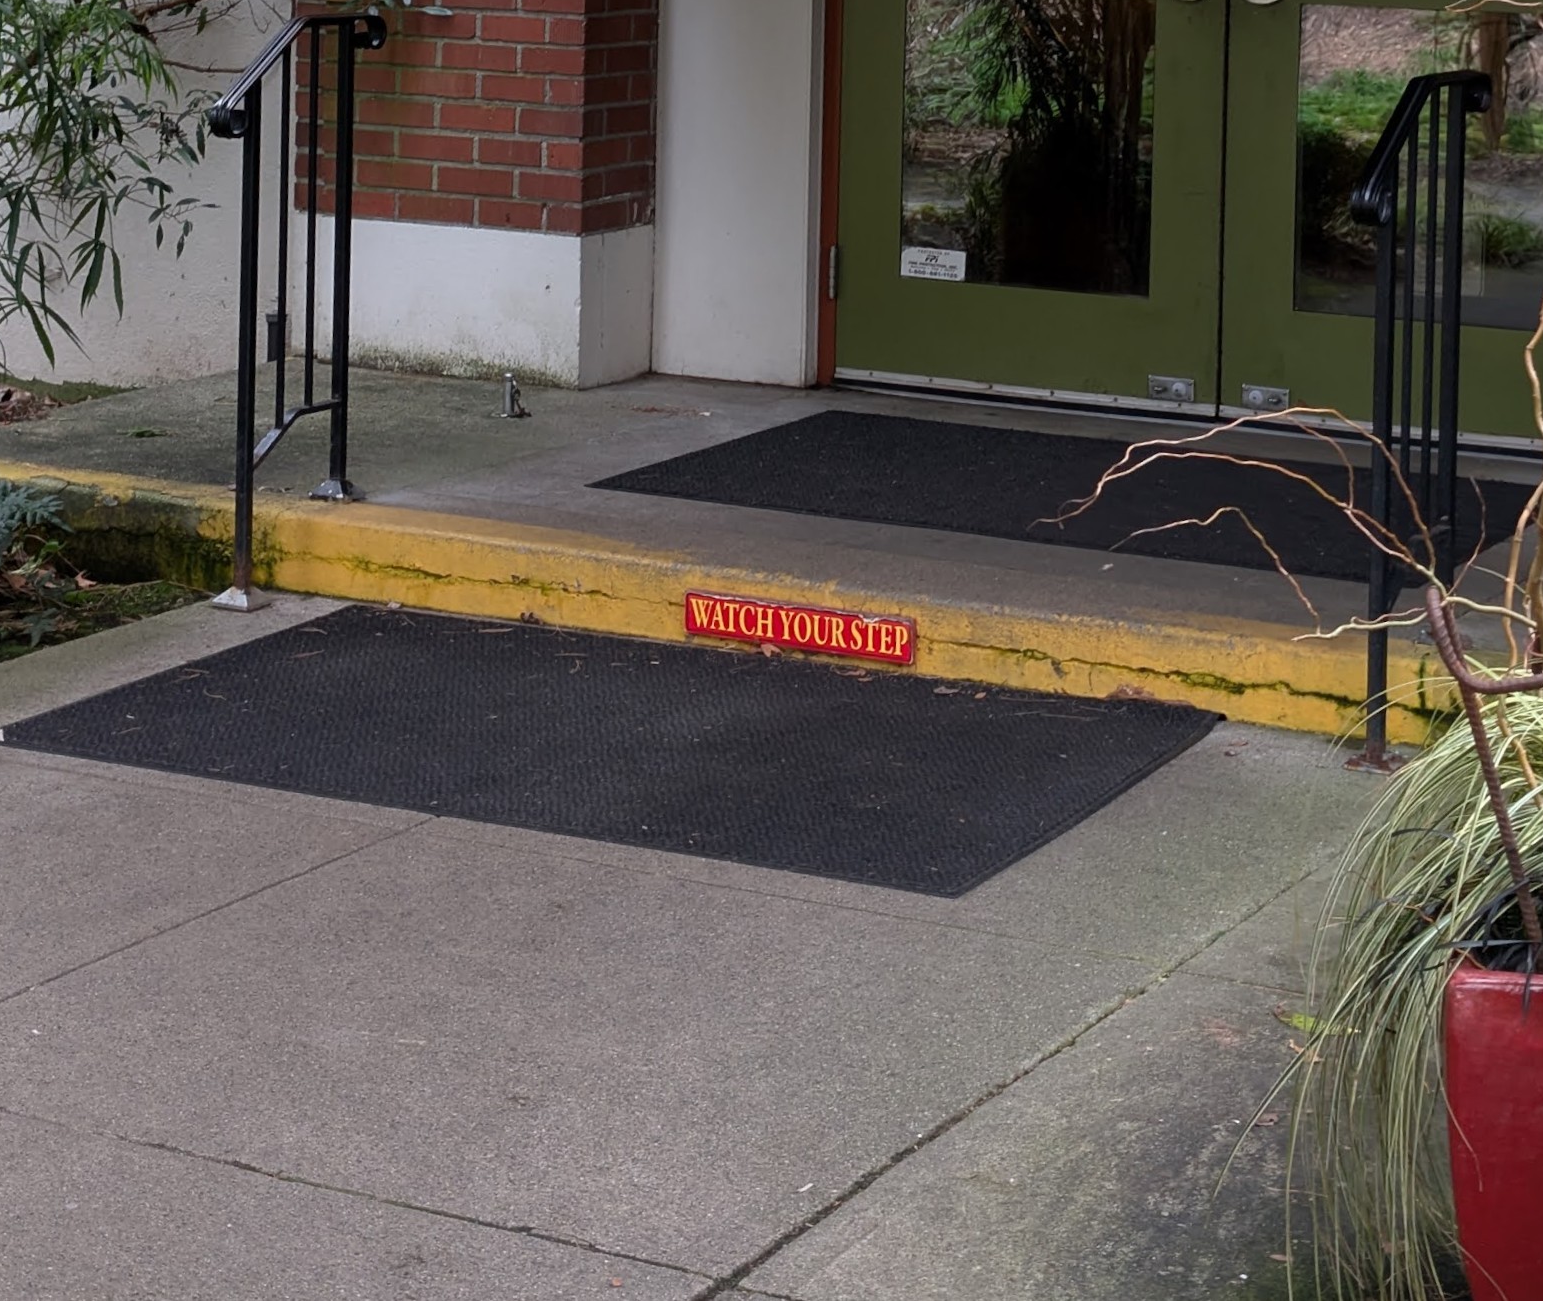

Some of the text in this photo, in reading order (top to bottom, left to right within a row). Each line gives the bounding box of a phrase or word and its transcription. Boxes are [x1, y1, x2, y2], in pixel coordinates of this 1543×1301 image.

[690, 598, 908, 656] WATCH YOUR STEP
